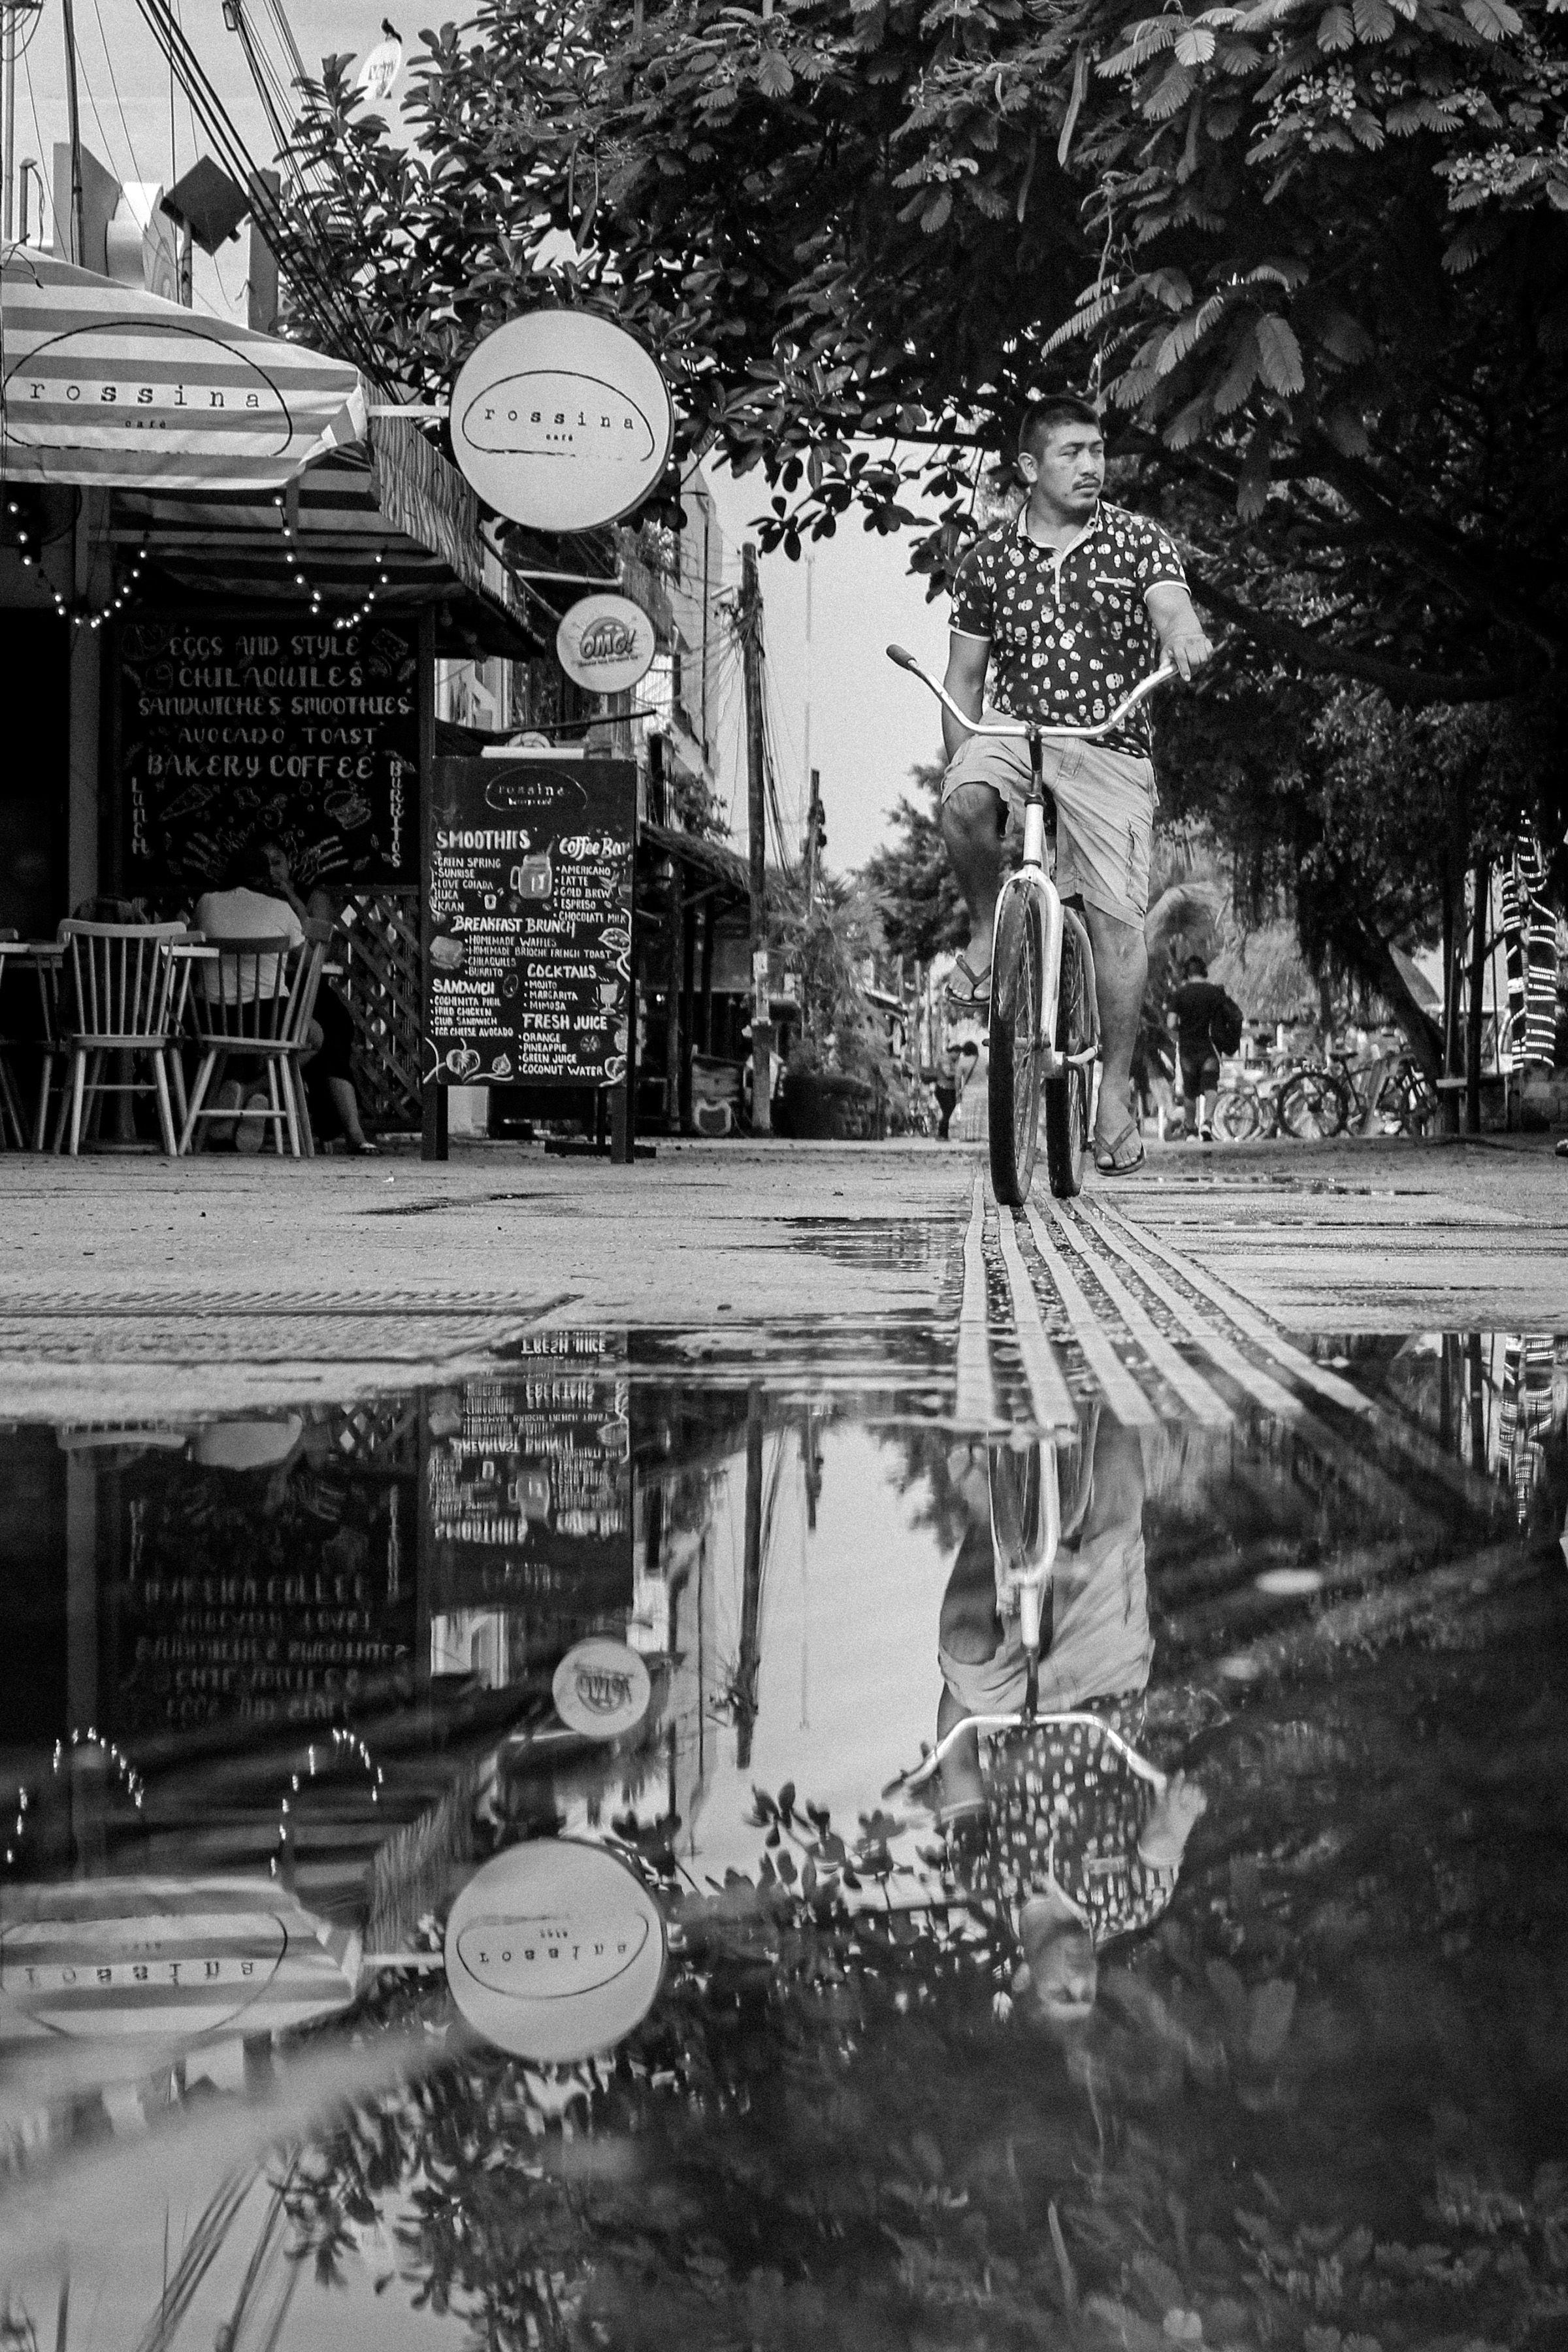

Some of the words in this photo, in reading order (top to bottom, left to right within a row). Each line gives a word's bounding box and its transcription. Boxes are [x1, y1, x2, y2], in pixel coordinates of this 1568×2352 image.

[29, 384, 260, 408] rossina
[484, 408, 634, 430] rossina
[169, 636, 224, 661] EGGS
[235, 636, 280, 655] AND
[290, 635, 360, 659] STYLE
[580, 629, 636, 660] OMG!
[179, 666, 364, 688] CHILAQUILES
[139, 696, 285, 716] SANDWICHES
[291, 696, 415, 715] SMOOTHIES
[178, 727, 286, 745] AVOCADO
[301, 727, 378, 745] TOAST
[148, 755, 261, 778] BAKERY
[269, 755, 374, 779] COFFEE
[436, 829, 531, 849] SMOOTHIES
[559, 836, 600, 861] Coffee
[601, 838, 630, 858] Bar
[467, 858, 501, 868] SPRING
[438, 868, 475, 879] SUNRISE
[561, 865, 611, 875] AMERICANO
[561, 875, 588, 887] LATTE
[585, 888, 611, 898] BREW
[438, 901, 465, 912] KAAN
[561, 898, 596, 910] ESPRESO
[559, 911, 604, 923] CHOCOLATE
[450, 915, 523, 933] BREAKFAST
[525, 917, 575, 938] BRUNCH
[584, 949, 612, 959] TOAST
[468, 967, 503, 977] BURRITO
[527, 963, 597, 979] COCKTAILS
[432, 978, 495, 996] SANDWICH
[529, 981, 557, 990] MOJITO
[529, 990, 578, 1000] MARGARITA
[529, 1000, 566, 1011] MIMOSA
[522, 1013, 570, 1030] FRESH
[574, 1015, 608, 1030] JUICE
[479, 1027, 514, 1037] AVOCADO
[523, 1032, 561, 1043] ORANGE
[523, 1053, 549, 1063] GREEN
[552, 1053, 577, 1064] JUICE
[523, 1064, 563, 1075] COCONUT
[567, 1065, 603, 1077] WATER
